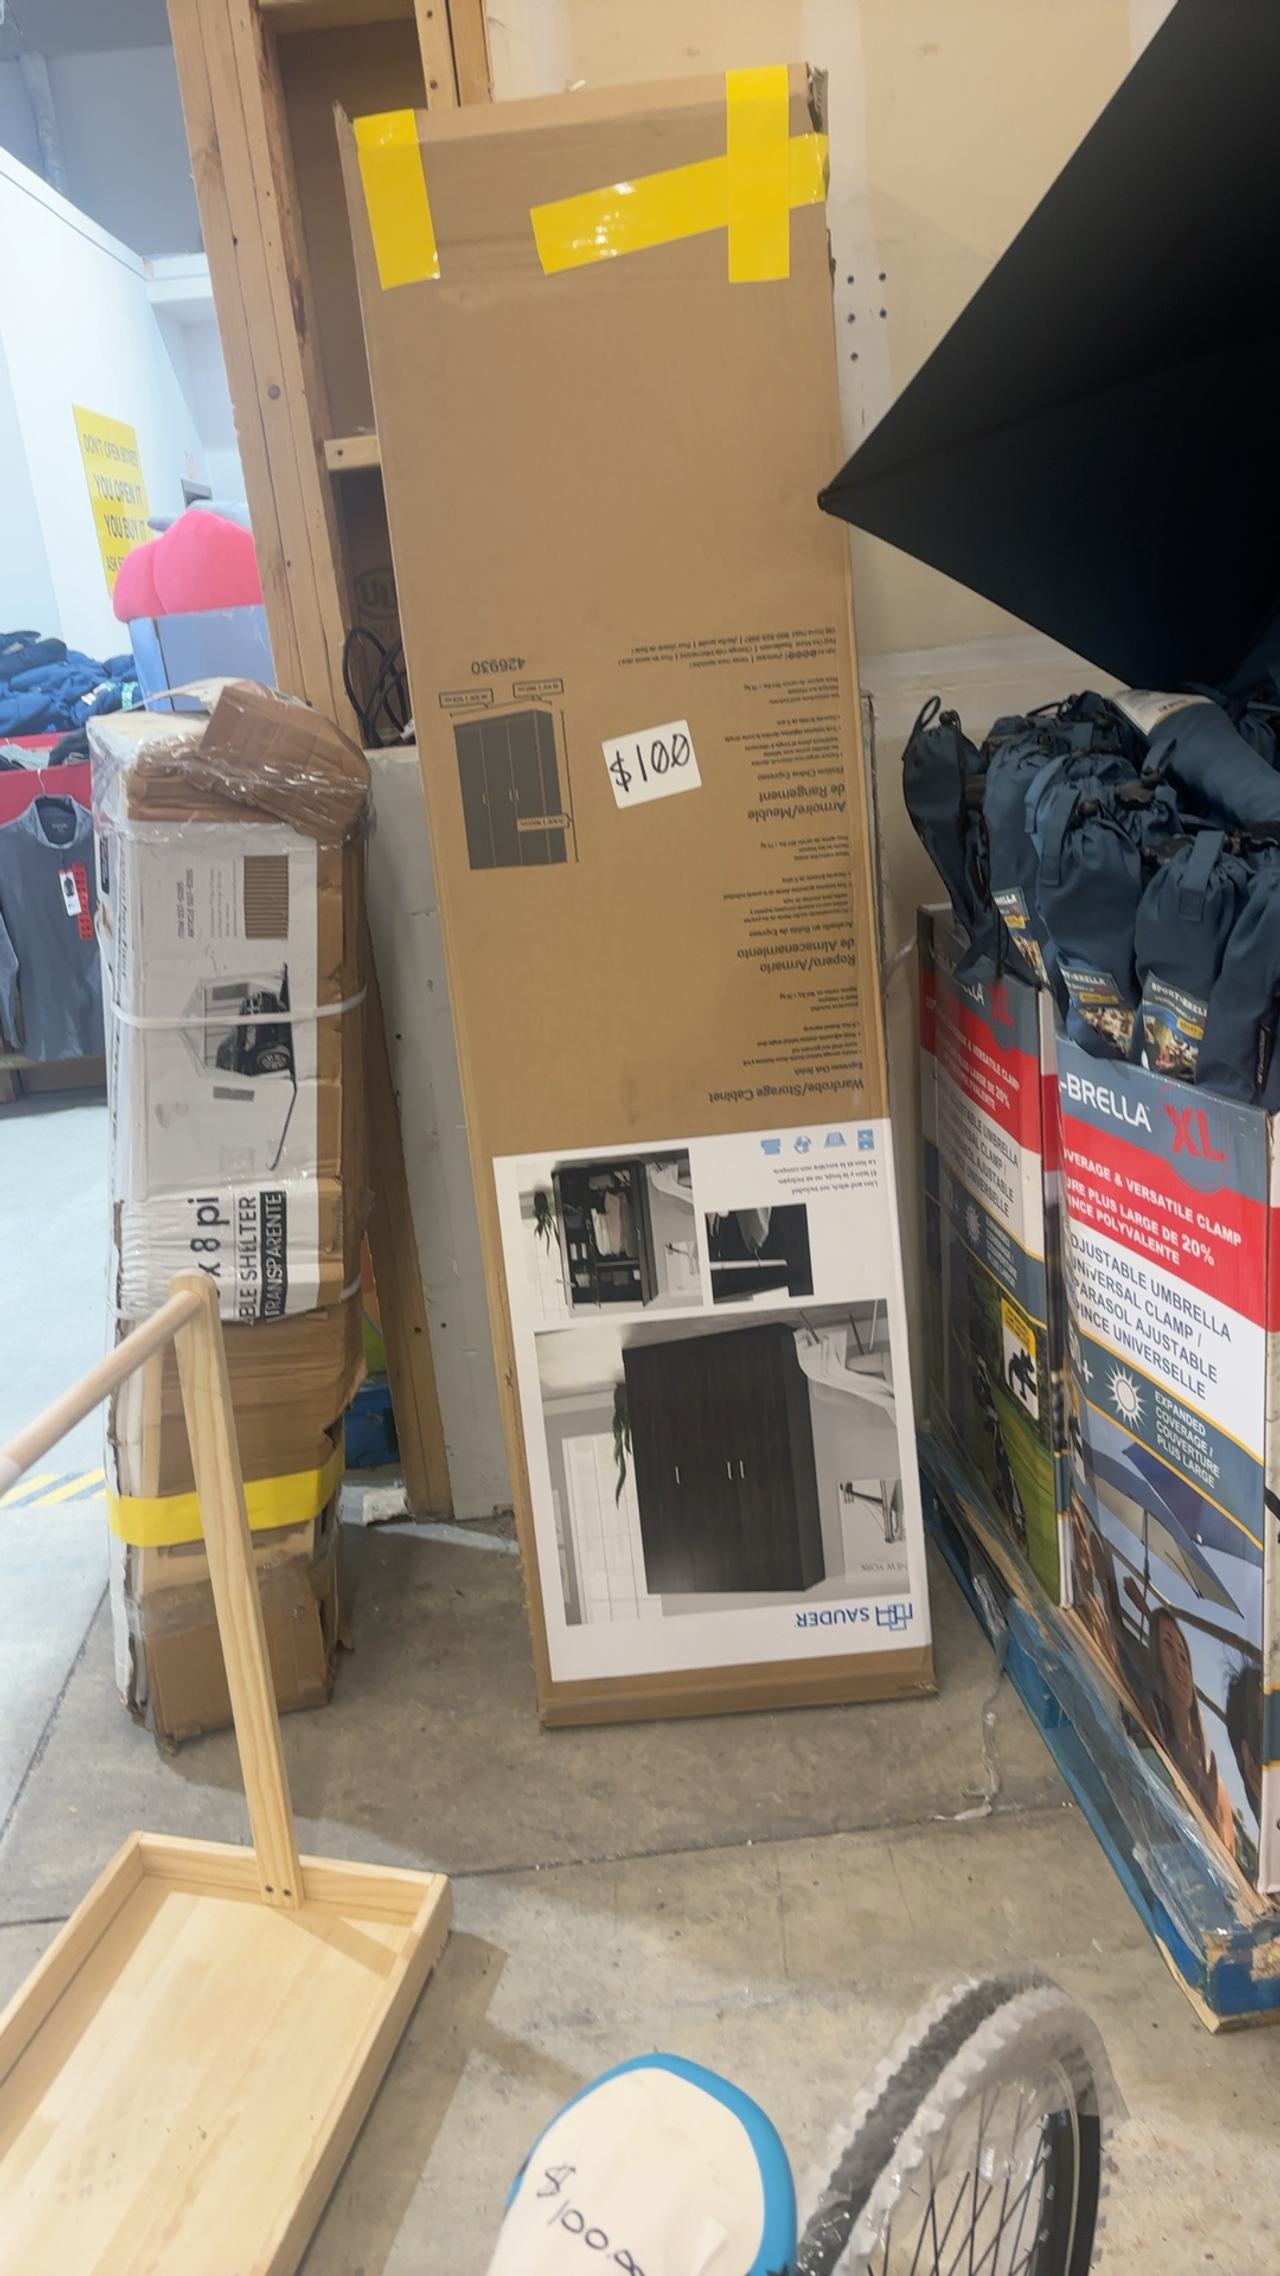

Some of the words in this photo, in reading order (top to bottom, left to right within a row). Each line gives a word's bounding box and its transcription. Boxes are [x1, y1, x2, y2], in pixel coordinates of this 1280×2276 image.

[104, 440, 120, 461] OPEN
[94, 474, 113, 500] YOU
[115, 481, 135, 504] OPEN
[136, 486, 143, 505] IT
[104, 514, 123, 539] YOU
[124, 518, 140, 540] BUY
[471, 657, 525, 674] 426930
[610, 733, 690, 793] $100
[758, 785, 827, 803] Rangement
[831, 784, 846, 796] de
[747, 801, 846, 823] Armoire/Meuble
[737, 940, 837, 960] Almacenamiento
[840, 938, 855, 950] de
[759, 954, 856, 975] Ropero/Armario
[708, 1090, 754, 1104] Cabinet
[756, 1078, 864, 1098] Wardrobe/Storage
[983, 1124, 1018, 1169] UMBRELLA
[1165, 1103, 1227, 1163] XL
[980, 1141, 1003, 1169] CLAMP
[187, 1197, 230, 1227] pi
[1114, 1173, 1123, 1188] &
[1125, 1177, 1194, 1224] VERSATILE
[1196, 1213, 1242, 1247] CLAMP
[239, 1196, 257, 1281] SHELTER
[1088, 1189, 1117, 1213] PLUS
[1119, 1204, 1159, 1236] LARGE
[1162, 1224, 1178, 1246] DE
[1181, 1235, 1215, 1267] 20%
[1097, 1210, 1181, 1266] POLYVALENTE
[190, 1238, 220, 1252] 8
[264, 1194, 283, 1316] TRANSPARENTE
[198, 1261, 221, 1278] x
[1144, 1300, 1193, 1340] CLAMP
[1151, 1278, 1232, 1342] UMBRELLA
[1113, 1324, 1206, 1400] UNIVERSELLE
[1135, 1318, 1218, 1384] AJUSTABLE
[1155, 1391, 1206, 1437] EXPANDED
[1155, 1406, 1208, 1453] COVERAGE
[1156, 1420, 1220, 1479] COUVERTURE
[1157, 1434, 1181, 1461] PLUS
[1183, 1454, 1215, 1489] LARGE
[795, 1606, 870, 1628] SAUDER
